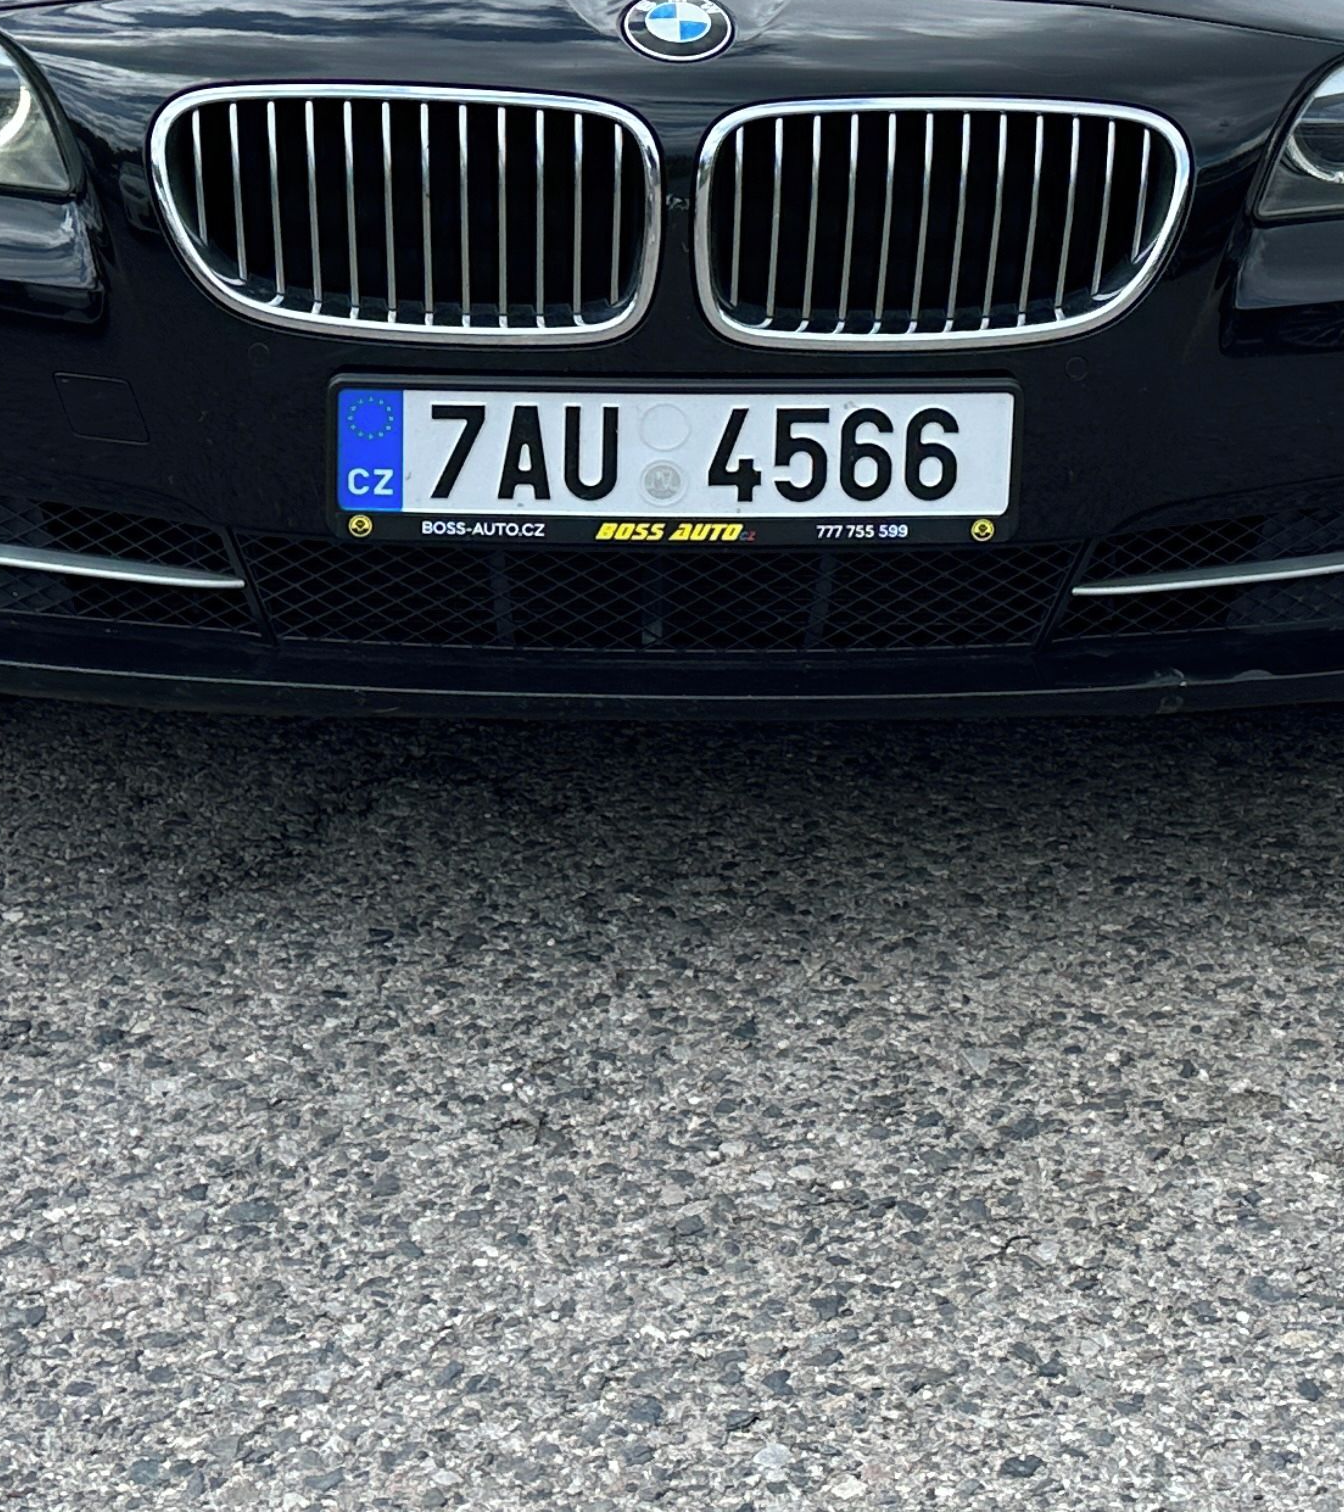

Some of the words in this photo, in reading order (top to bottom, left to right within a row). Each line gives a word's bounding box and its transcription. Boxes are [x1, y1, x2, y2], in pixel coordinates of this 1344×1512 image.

[431, 405, 619, 502] 7AU
[707, 407, 959, 504] 4566
[347, 468, 394, 496] CZ
[421, 521, 545, 537] BOSS-AUTO.CZ
[595, 522, 666, 541] BOSS
[668, 523, 744, 541] AUTO
[816, 525, 843, 539] 777
[846, 525, 875, 538] 755
[878, 524, 908, 538] 599
